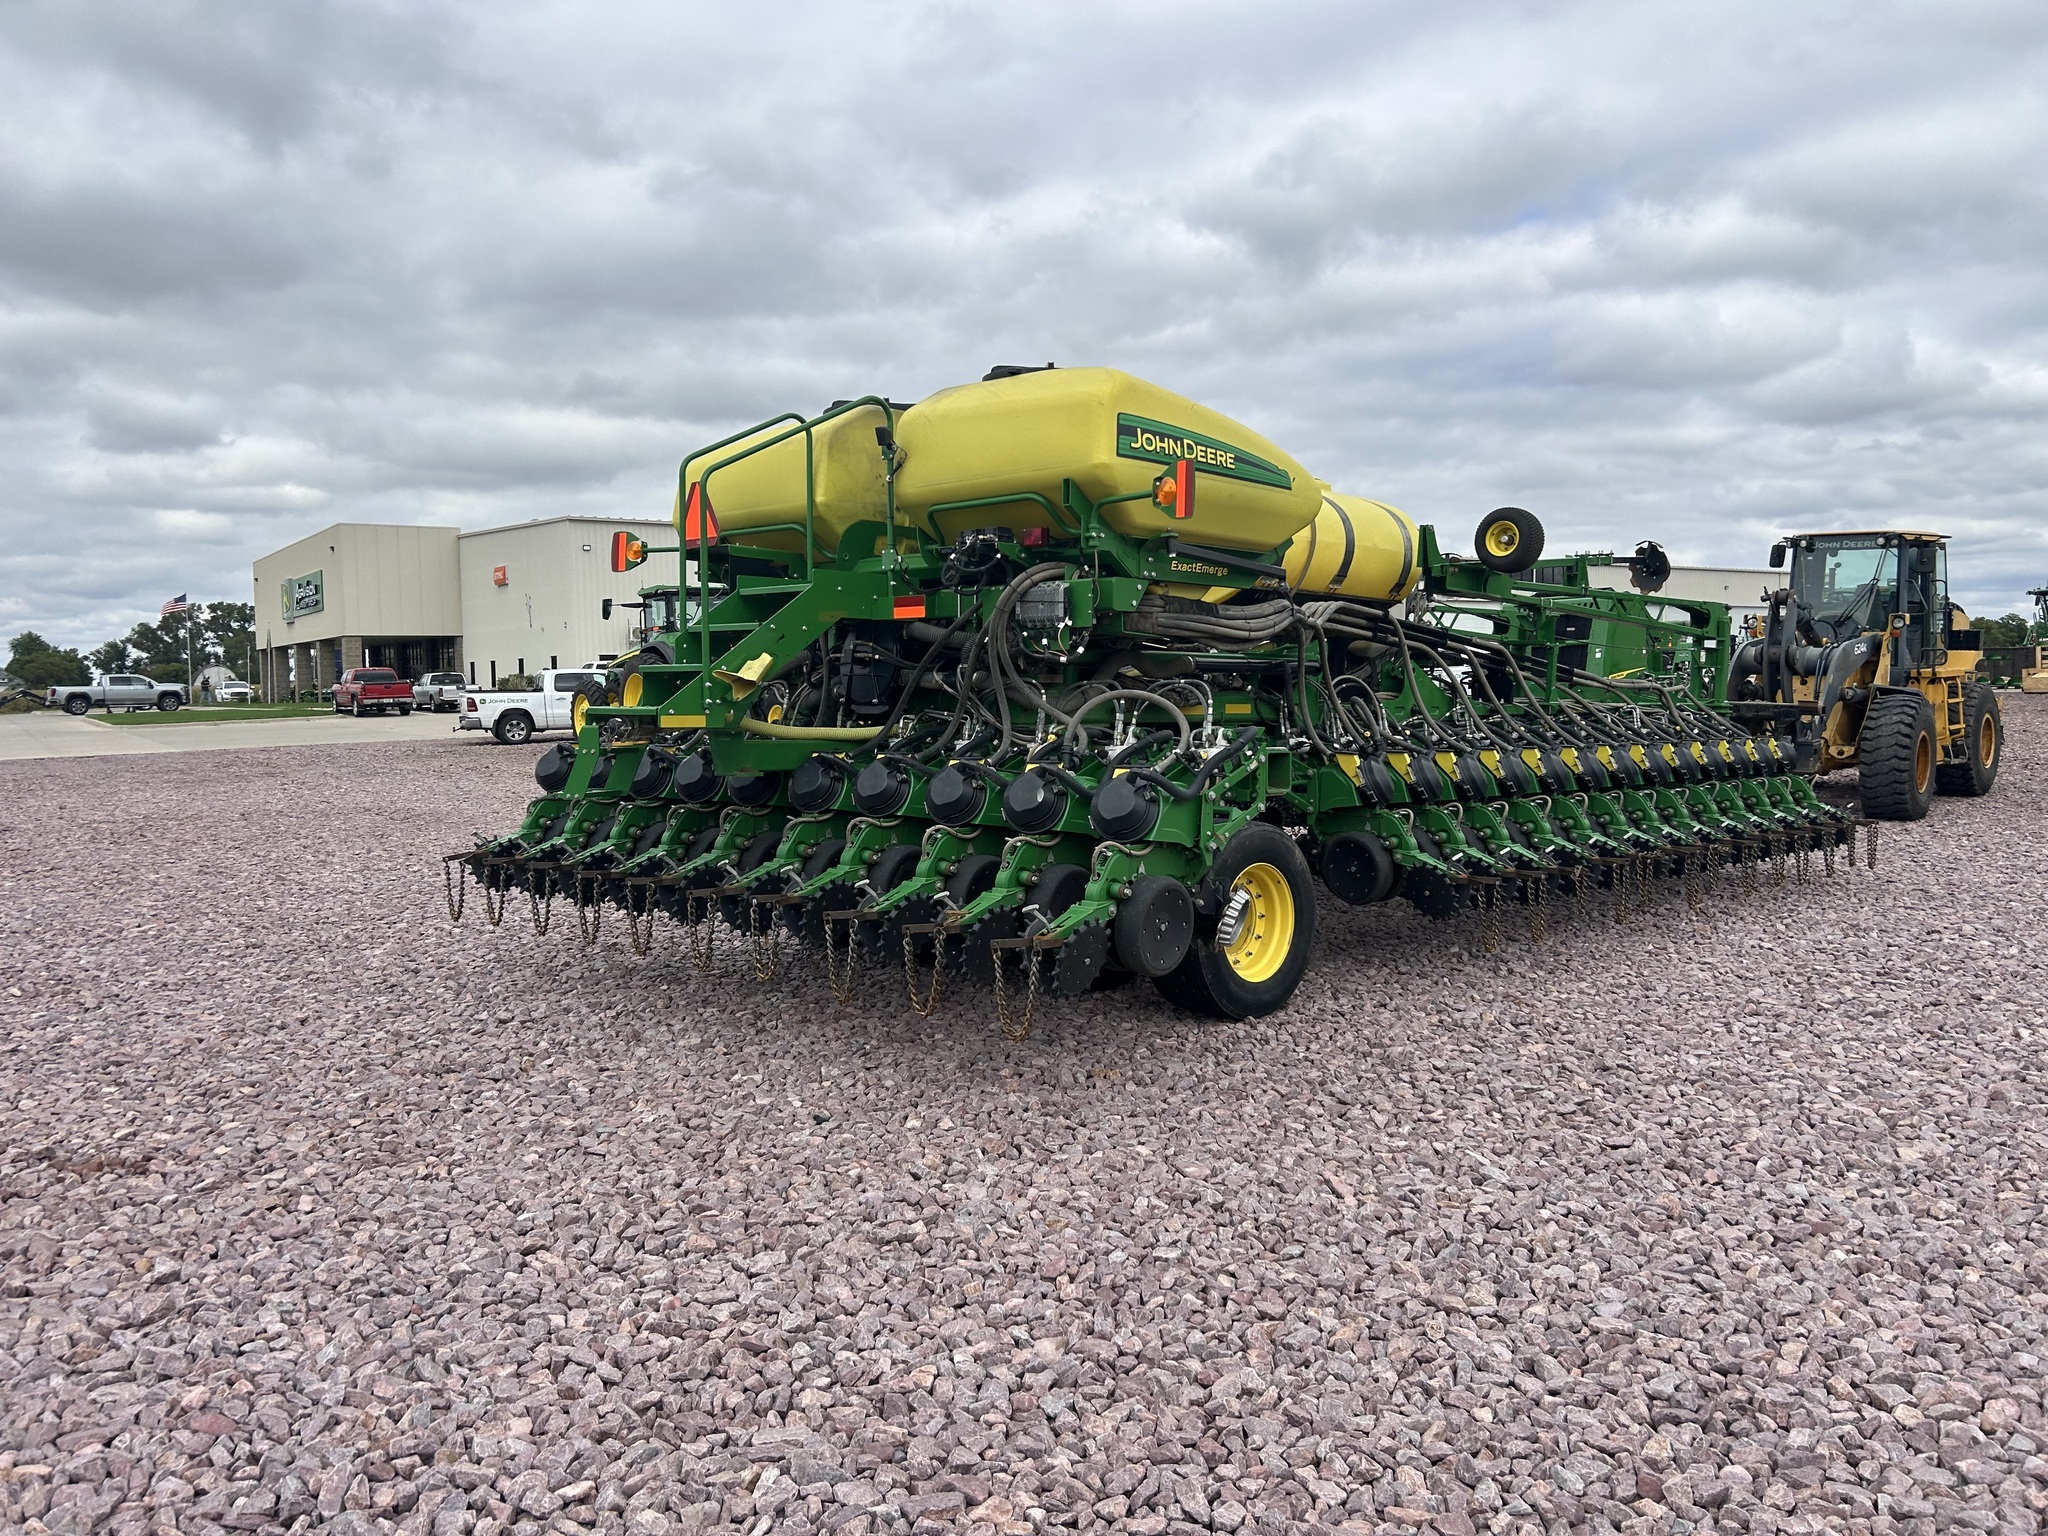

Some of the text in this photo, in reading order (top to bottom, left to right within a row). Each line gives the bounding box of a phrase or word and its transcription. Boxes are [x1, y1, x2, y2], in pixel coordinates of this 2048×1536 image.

[1130, 427, 1236, 469] JOHN DEERE
[1812, 541, 1840, 549] JOHN
[1170, 560, 1229, 577] ExactEmerge
